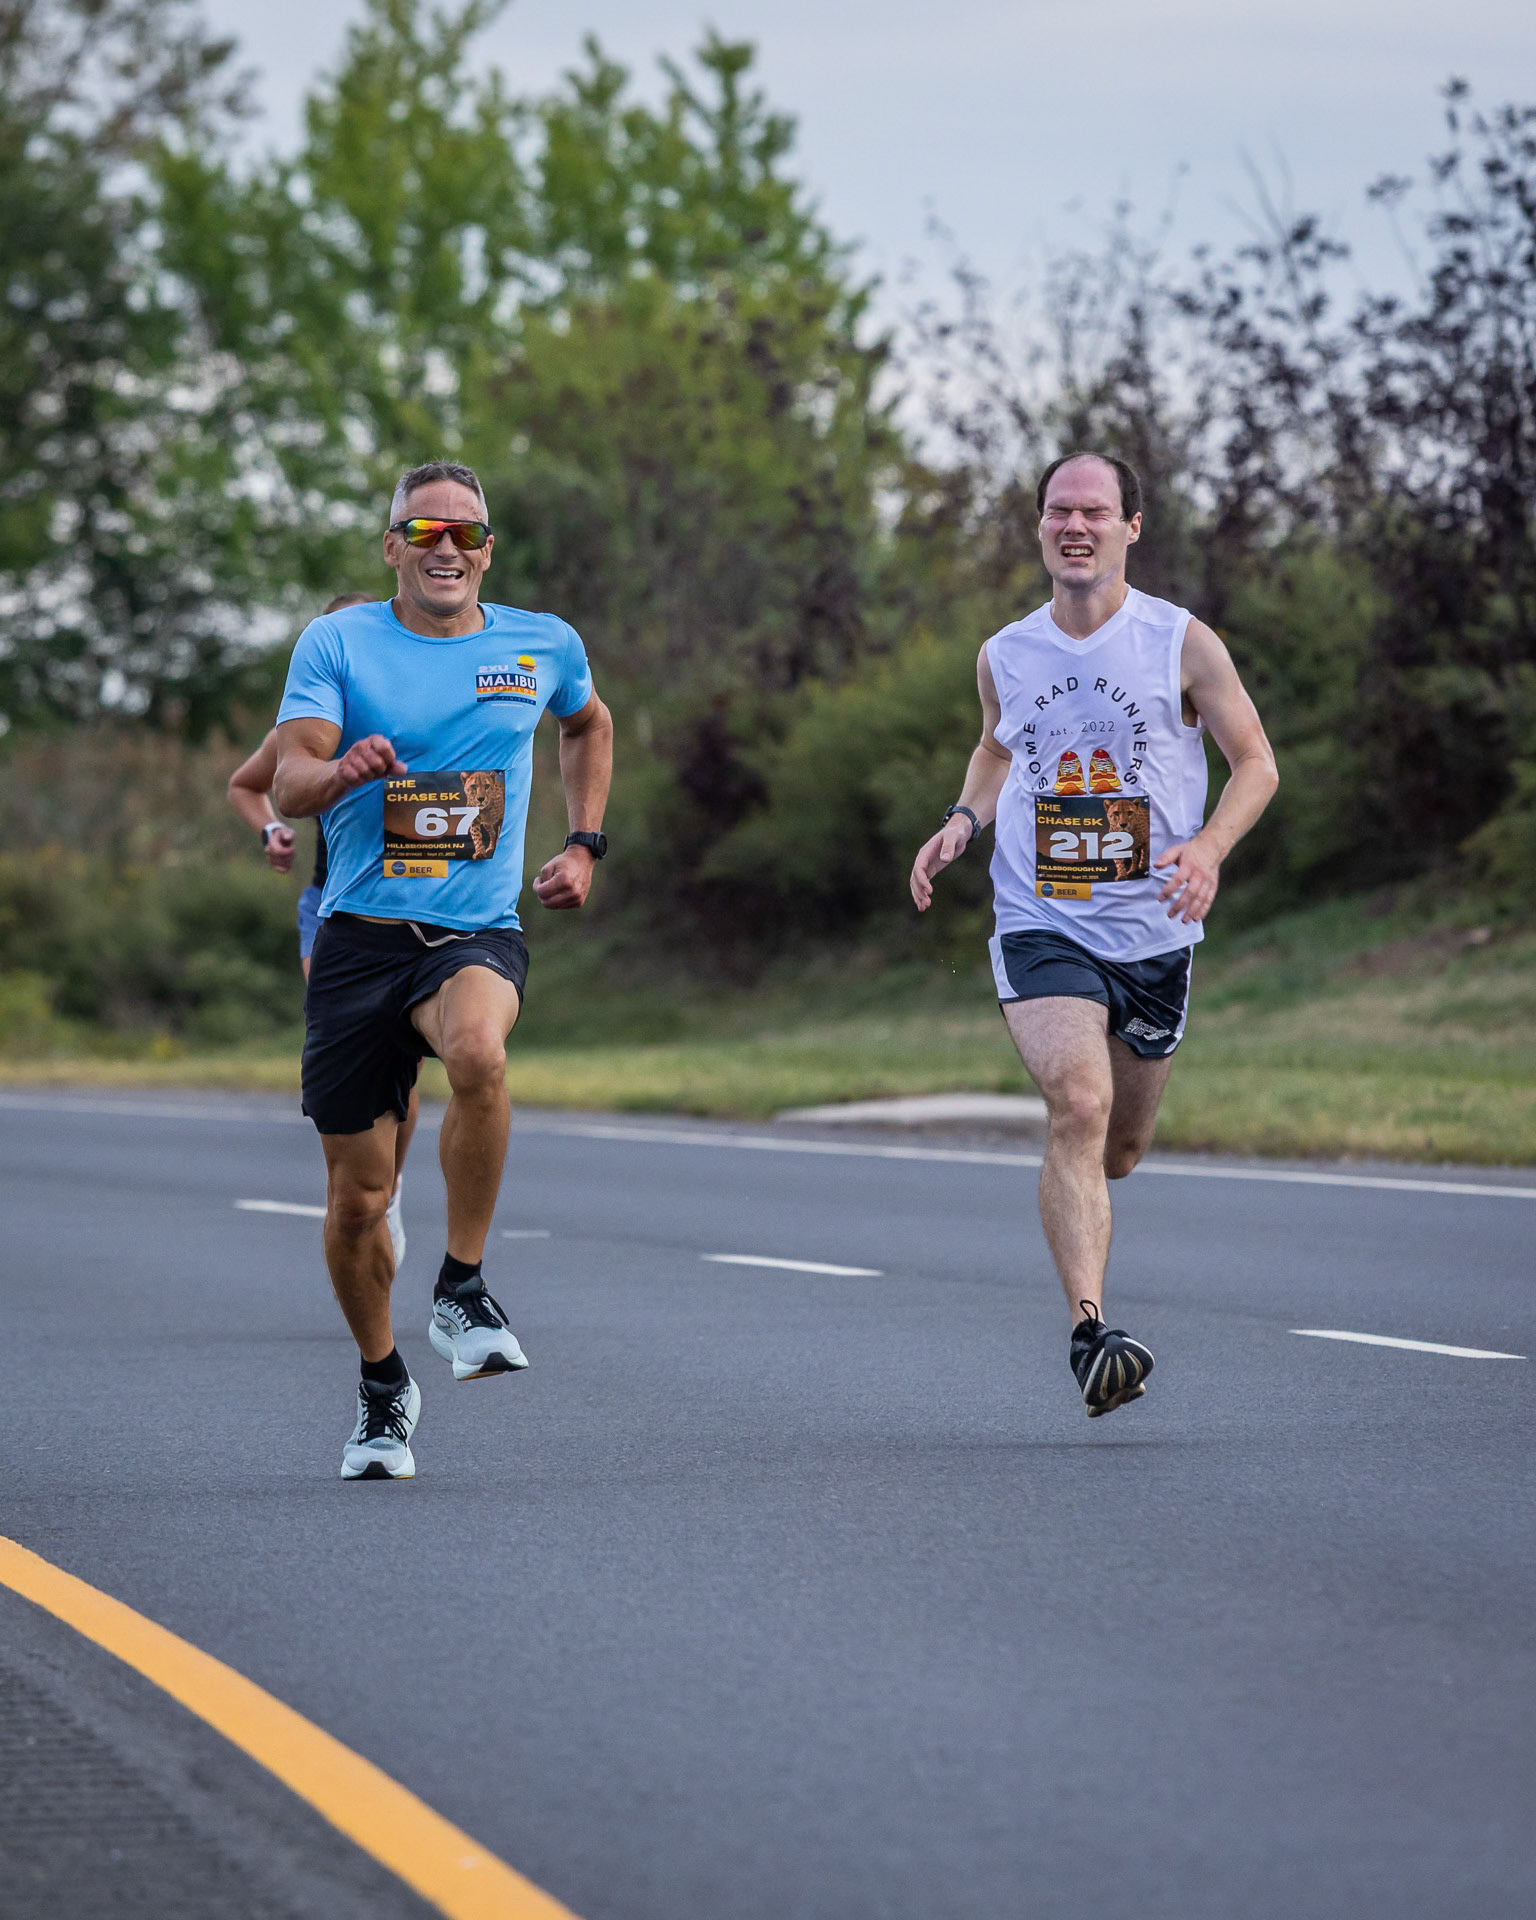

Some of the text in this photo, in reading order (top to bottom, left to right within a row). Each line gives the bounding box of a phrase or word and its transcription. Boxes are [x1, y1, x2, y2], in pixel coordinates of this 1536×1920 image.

[478, 664, 508, 673] 2XU
[478, 674, 536, 690] MALIBU
[1081, 721, 1115, 733] 2022
[1024, 677, 1147, 790] SOME RAD RUNNERS
[387, 779, 416, 788] THE
[386, 792, 460, 802] CHASE 5K
[1036, 803, 1061, 812] THE
[414, 806, 480, 837] 67
[1037, 816, 1103, 827] CHASE 5K
[1049, 830, 1134, 860] 212
[409, 866, 433, 874] BEER
[1056, 888, 1078, 896] BEER
